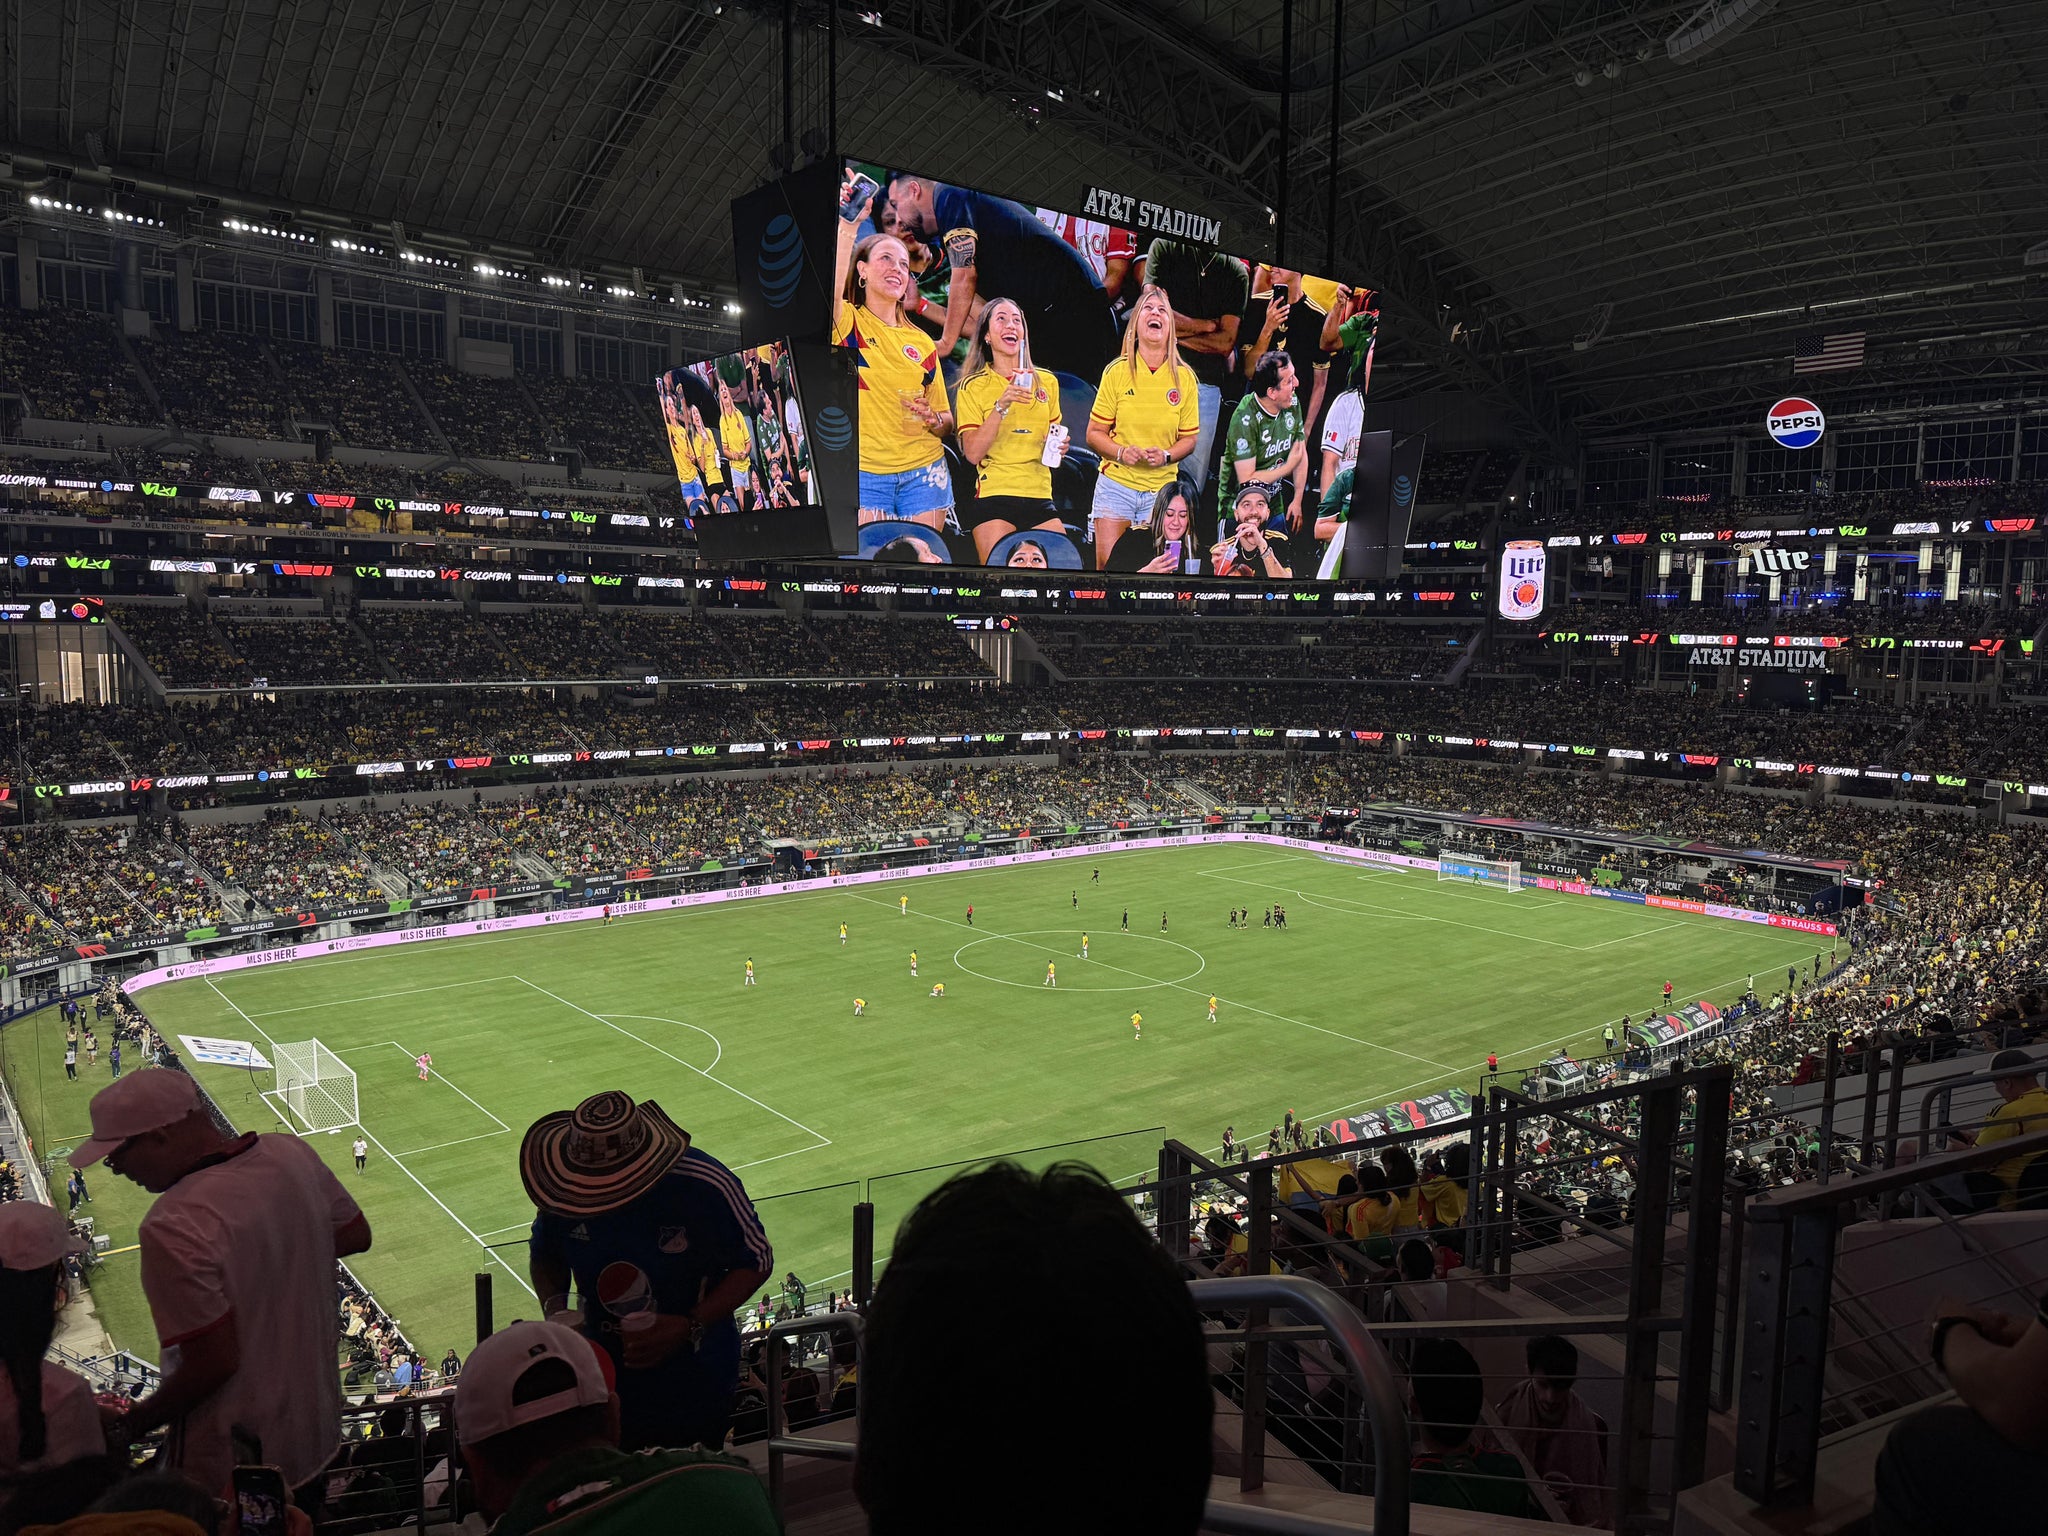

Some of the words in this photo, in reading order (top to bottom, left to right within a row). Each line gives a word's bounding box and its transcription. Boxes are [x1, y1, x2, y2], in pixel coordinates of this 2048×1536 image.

[1084, 187, 1136, 223] AT&T
[1138, 200, 1222, 246] STADIUM
[1770, 416, 1821, 430] PEPSI
[1265, 434, 1292, 456] telcel
[0, 474, 47, 488] OLOMBIA
[55, 478, 88, 488] PRESENTED
[89, 481, 97, 489] BY
[113, 483, 134, 491] AT&T
[274, 492, 294, 504] VS
[399, 500, 440, 512] MÉXICO
[444, 502, 462, 514] VS
[464, 505, 504, 517] COLOMBIA
[659, 517, 674, 528] VS
[1952, 520, 1973, 533] VS
[1589, 535, 1603, 545] VS
[1680, 532, 1714, 541] MÉXICO
[1717, 530, 1733, 540] VS
[1735, 530, 1772, 539] COLOMBIA
[30, 558, 57, 566] AT&T
[1750, 549, 1810, 577] Lite
[233, 562, 257, 574] VS
[1510, 558, 1544, 578] Lite
[386, 568, 436, 579] MÉXICO
[441, 569, 461, 580] VS
[464, 570, 512, 582] COLOMBIA
[568, 575, 586, 583] AT&T
[696, 579, 713, 589] VS
[804, 583, 841, 593] MÉXICO
[844, 584, 859, 593] VS
[861, 585, 897, 595] COLOMBIA
[1046, 590, 1061, 598] VS
[1140, 592, 1174, 600] MÉXICO
[1177, 592, 1193, 600] VS
[1194, 592, 1230, 601] COLOMBIA
[1386, 592, 1403, 600] VS
[1697, 636, 1721, 644] MEX
[1792, 637, 1816, 646] COL
[1903, 640, 1964, 648] MEXTOUR
[1688, 648, 1734, 666] AT&T
[1738, 649, 1826, 668] STADIUM
[1058, 731, 1070, 739] VS
[1160, 728, 1172, 737] VS
[1173, 728, 1202, 736] COLOMBIA
[1328, 730, 1342, 738] VS
[774, 742, 789, 750] VS
[860, 738, 891, 747] MÉXICO
[893, 737, 906, 746] VS
[907, 736, 936, 745] COLOMBIA
[1474, 738, 1488, 747] VS
[1489, 739, 1519, 749] COLOMBIA
[532, 752, 572, 762] MÉXICO
[575, 752, 591, 761] VS
[594, 750, 630, 760] COLOMBIA
[1654, 752, 1670, 761] VS
[416, 760, 435, 771] VS
[1755, 760, 1795, 771] MÉXICO
[1798, 763, 1815, 774] VS
[1818, 765, 1859, 778] COLOMBIA
[1912, 774, 1930, 782] AT&T
[69, 780, 125, 794] MÉXICO
[131, 778, 153, 791] VS
[157, 775, 208, 788] COLOMBIA
[216, 775, 245, 783] PRESENTED
[269, 771, 289, 779] AT&T
[1529, 862, 1578, 875] MEXTOUR
[506, 884, 540, 893] MEXTOUR
[594, 887, 610, 896] AT&T
[745, 887, 761, 896] HERE
[330, 907, 369, 918] MEXTOUR
[629, 902, 647, 912] HERE
[1682, 902, 1704, 912] DEPOT
[1781, 918, 1822, 932] STRAUSS
[400, 930, 414, 941] MLS
[416, 930, 424, 939] IS
[425, 927, 447, 938] HERE
[123, 937, 169, 949] MEXTOUR
[336, 941, 345, 950] tv
[247, 954, 261, 965] MLS
[263, 953, 271, 963] IS
[274, 948, 297, 962] HERE
[175, 966, 185, 976] tv
